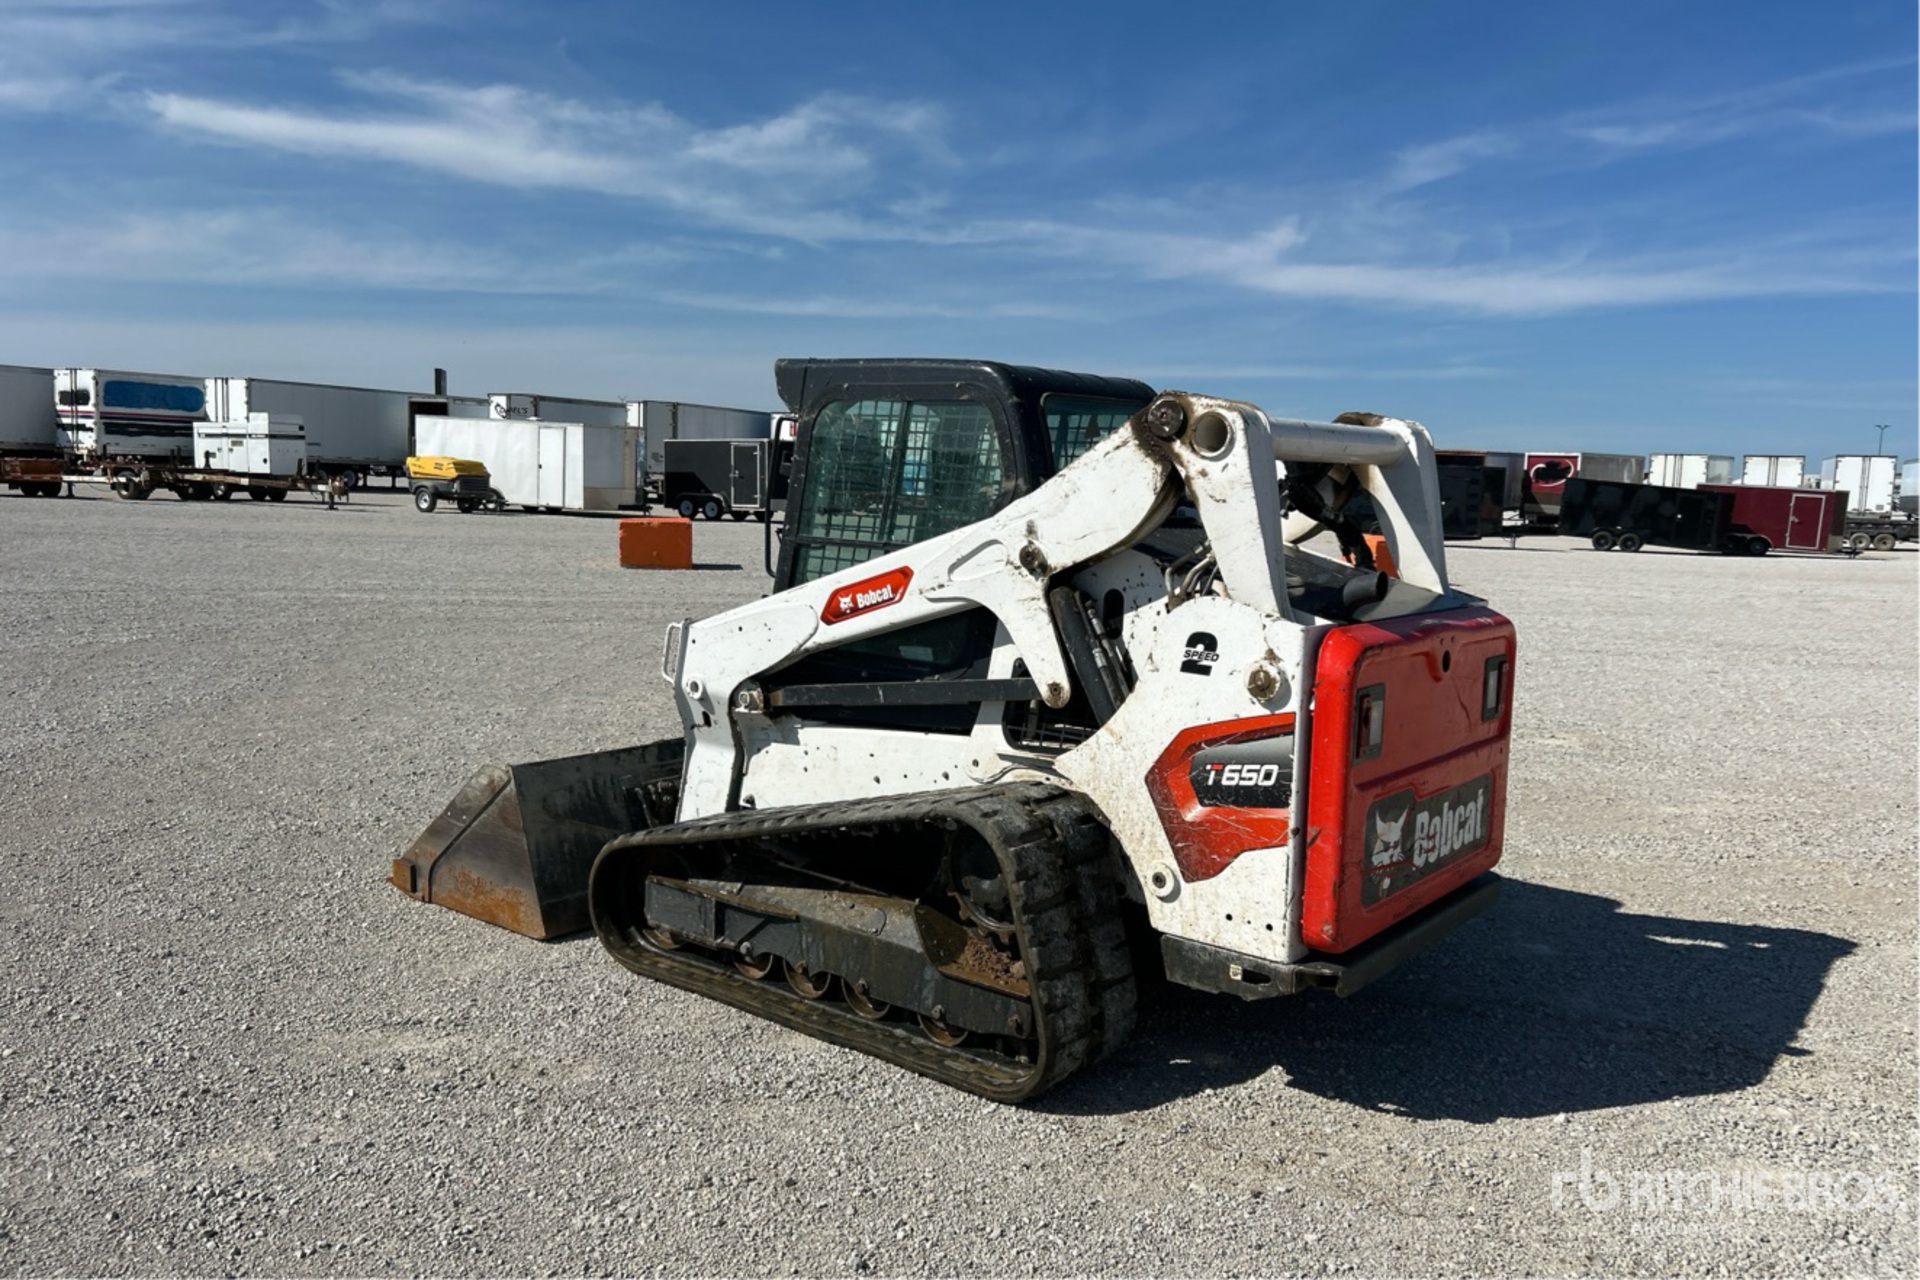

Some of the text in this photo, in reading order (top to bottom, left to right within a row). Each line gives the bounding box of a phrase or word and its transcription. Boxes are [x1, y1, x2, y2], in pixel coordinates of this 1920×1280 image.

[856, 584, 893, 608] Bobcat
[1180, 631, 1218, 676] 2
[1183, 649, 1219, 662] SPEED
[1206, 763, 1279, 786] T650
[1412, 788, 1484, 870] Bobcat
